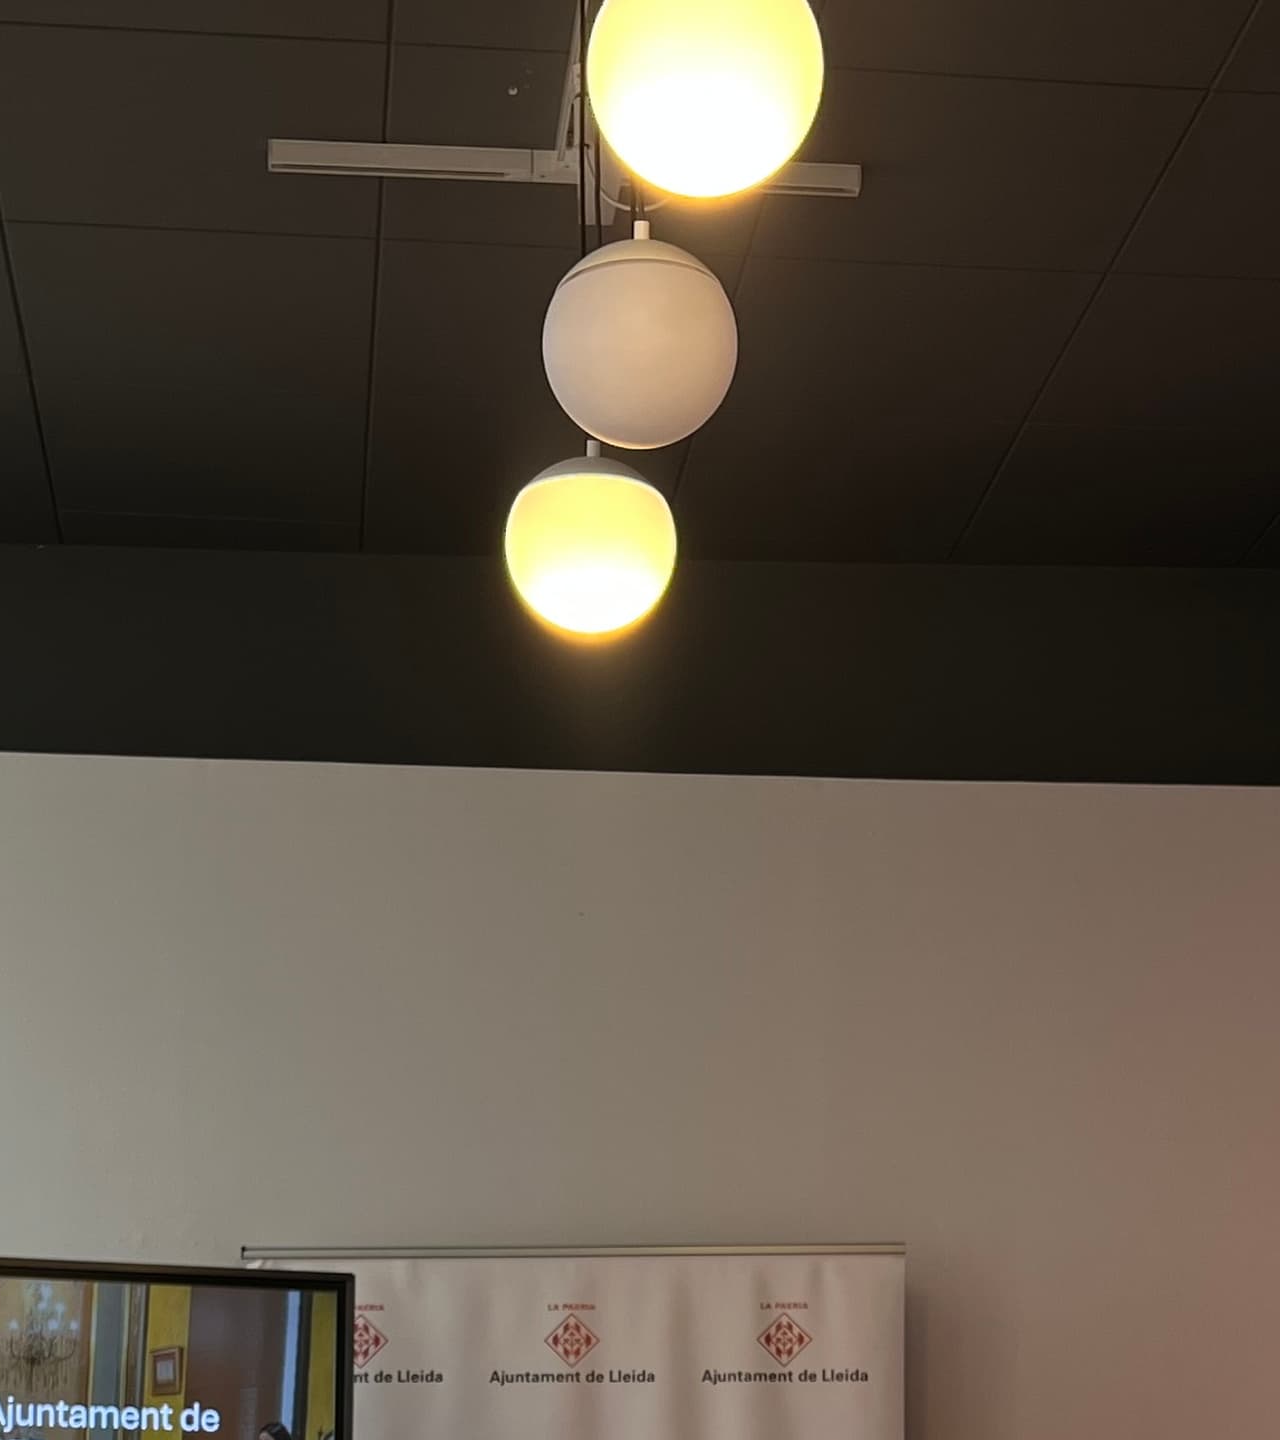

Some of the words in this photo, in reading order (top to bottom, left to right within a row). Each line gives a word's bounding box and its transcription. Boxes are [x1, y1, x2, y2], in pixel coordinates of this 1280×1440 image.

[760, 1302, 771, 1310] LA
[775, 1302, 808, 1310] PAERIA
[374, 1370, 393, 1383] de
[397, 1370, 443, 1383] Lleida
[489, 1370, 581, 1386] Ajuntament
[585, 1370, 604, 1383] de
[608, 1370, 656, 1383] Lleida
[701, 1369, 793, 1385] Ajuntament
[798, 1369, 817, 1383] de
[822, 1369, 869, 1383] Lleida
[180, 1401, 220, 1432] de
